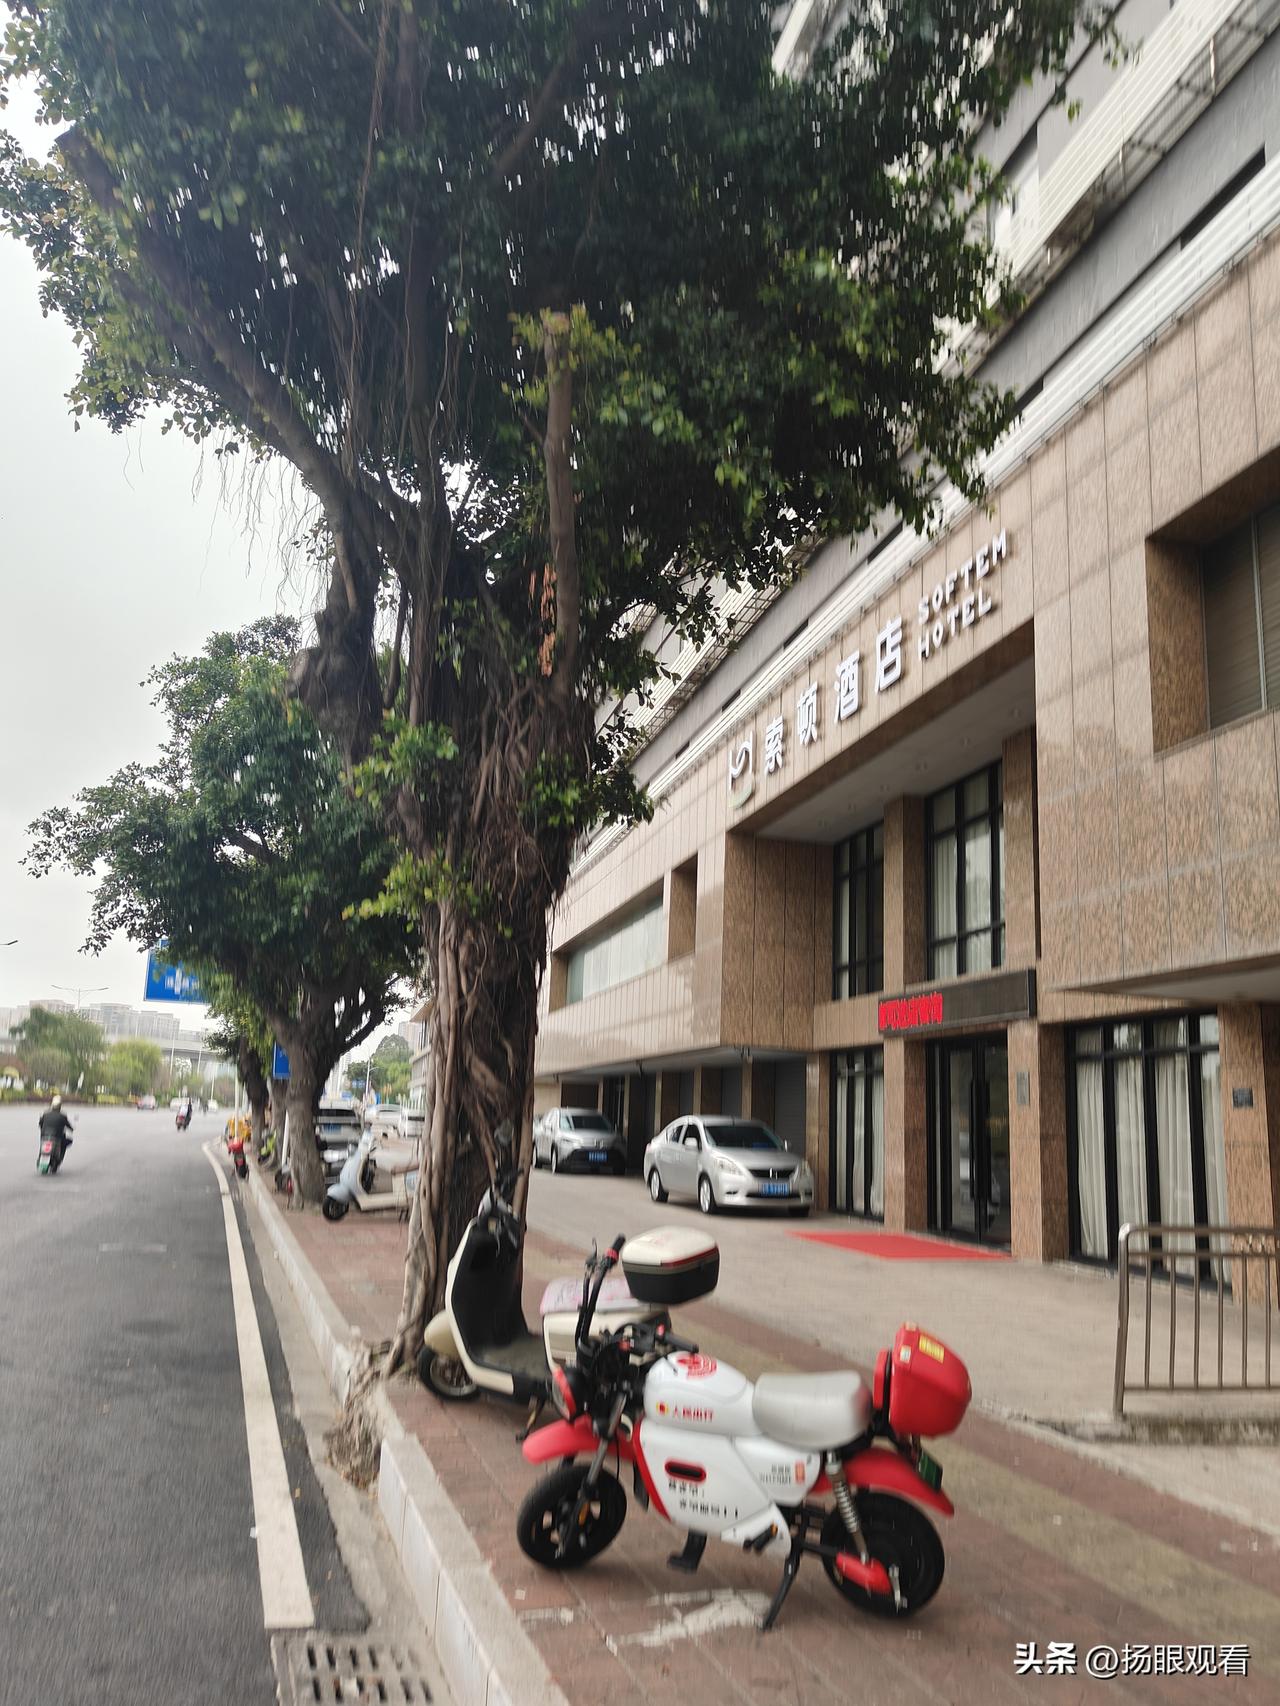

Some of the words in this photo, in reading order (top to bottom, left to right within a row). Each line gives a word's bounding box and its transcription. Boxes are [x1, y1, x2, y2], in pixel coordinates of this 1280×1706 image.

[918, 528, 1007, 624] SOFTEM
[918, 587, 993, 660] HOTEL
[765, 615, 902, 775] 索顿酒店
